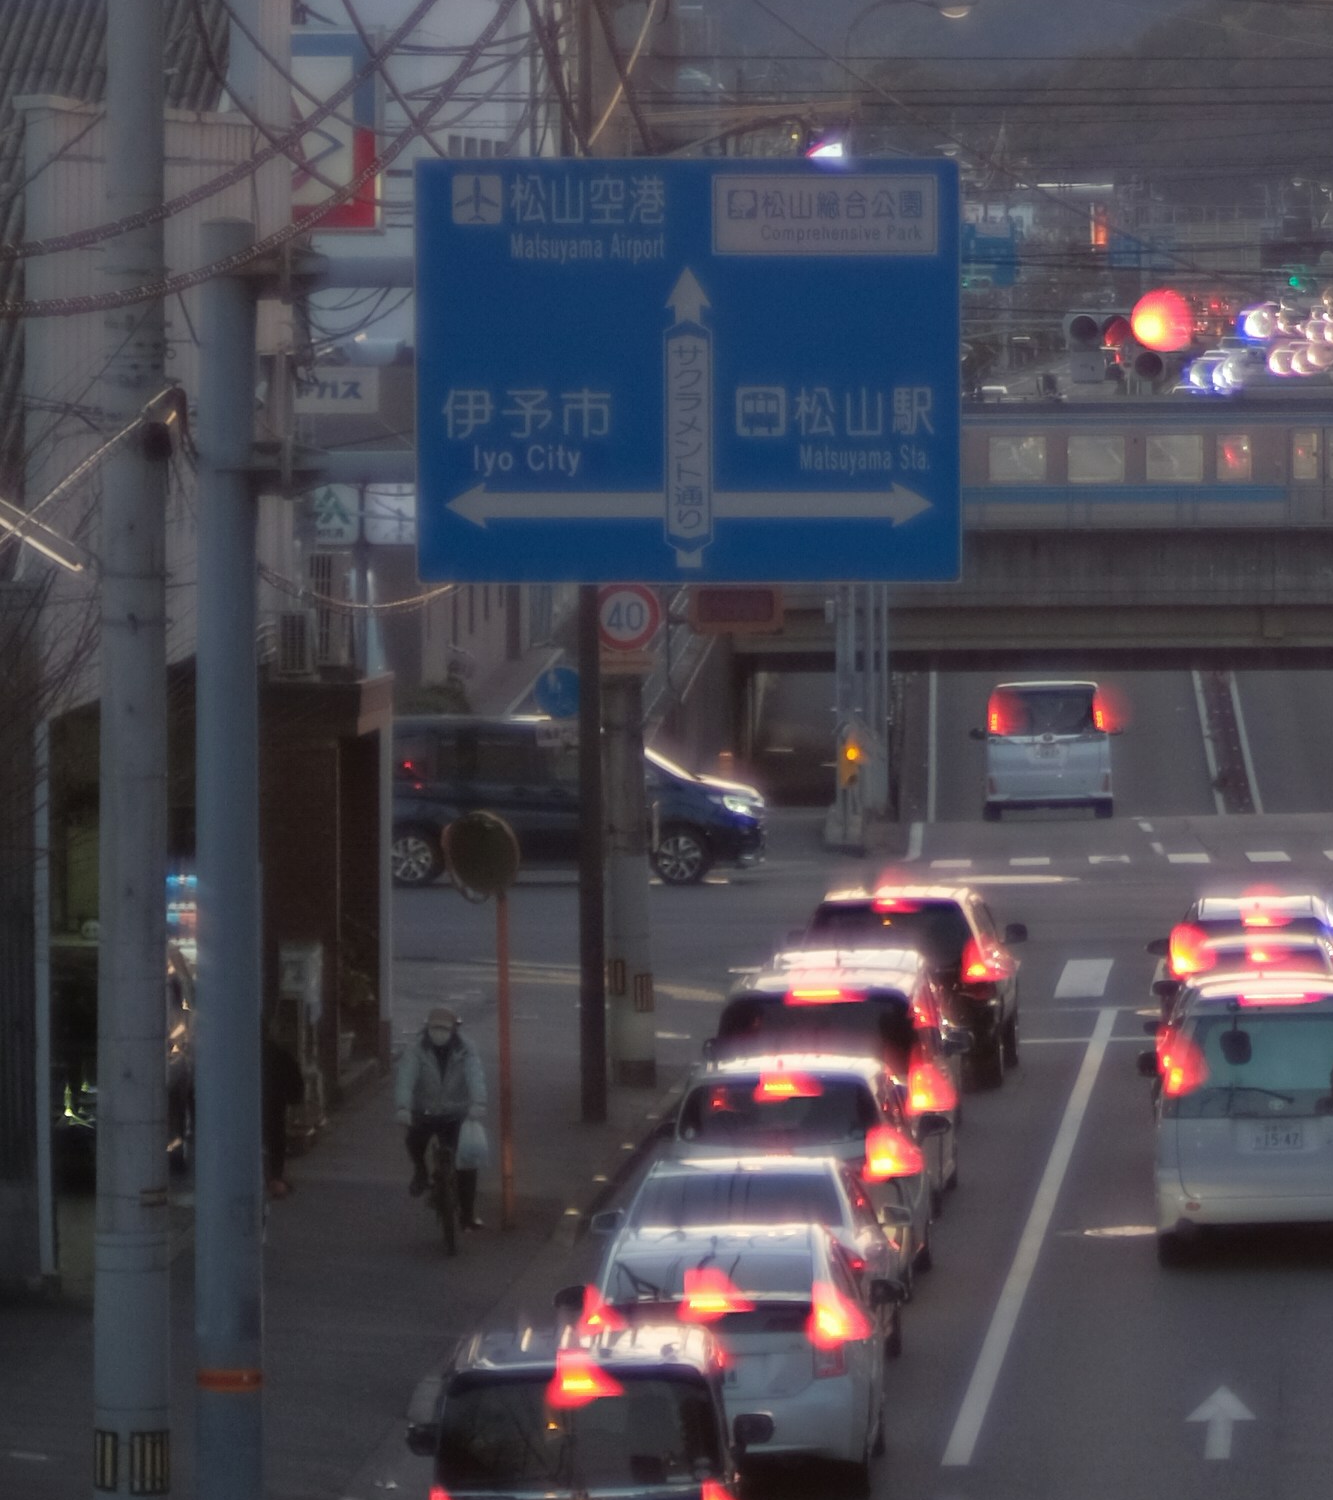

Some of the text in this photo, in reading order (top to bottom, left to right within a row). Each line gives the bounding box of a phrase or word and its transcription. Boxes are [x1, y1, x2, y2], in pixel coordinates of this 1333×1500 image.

[511, 173, 665, 225] 松山空港
[761, 190, 923, 219] 松山総合公園
[511, 232, 664, 262] Matsuyama Airport
[761, 224, 923, 243] Comprehensive Park
[442, 388, 612, 440] 伊予市
[794, 386, 935, 437] 松山駅
[673, 343, 703, 530] サクラメント通り
[473, 444, 581, 477] Iyo City
[801, 445, 930, 475] Matsuyama Sta.
[607, 601, 643, 631] 40
